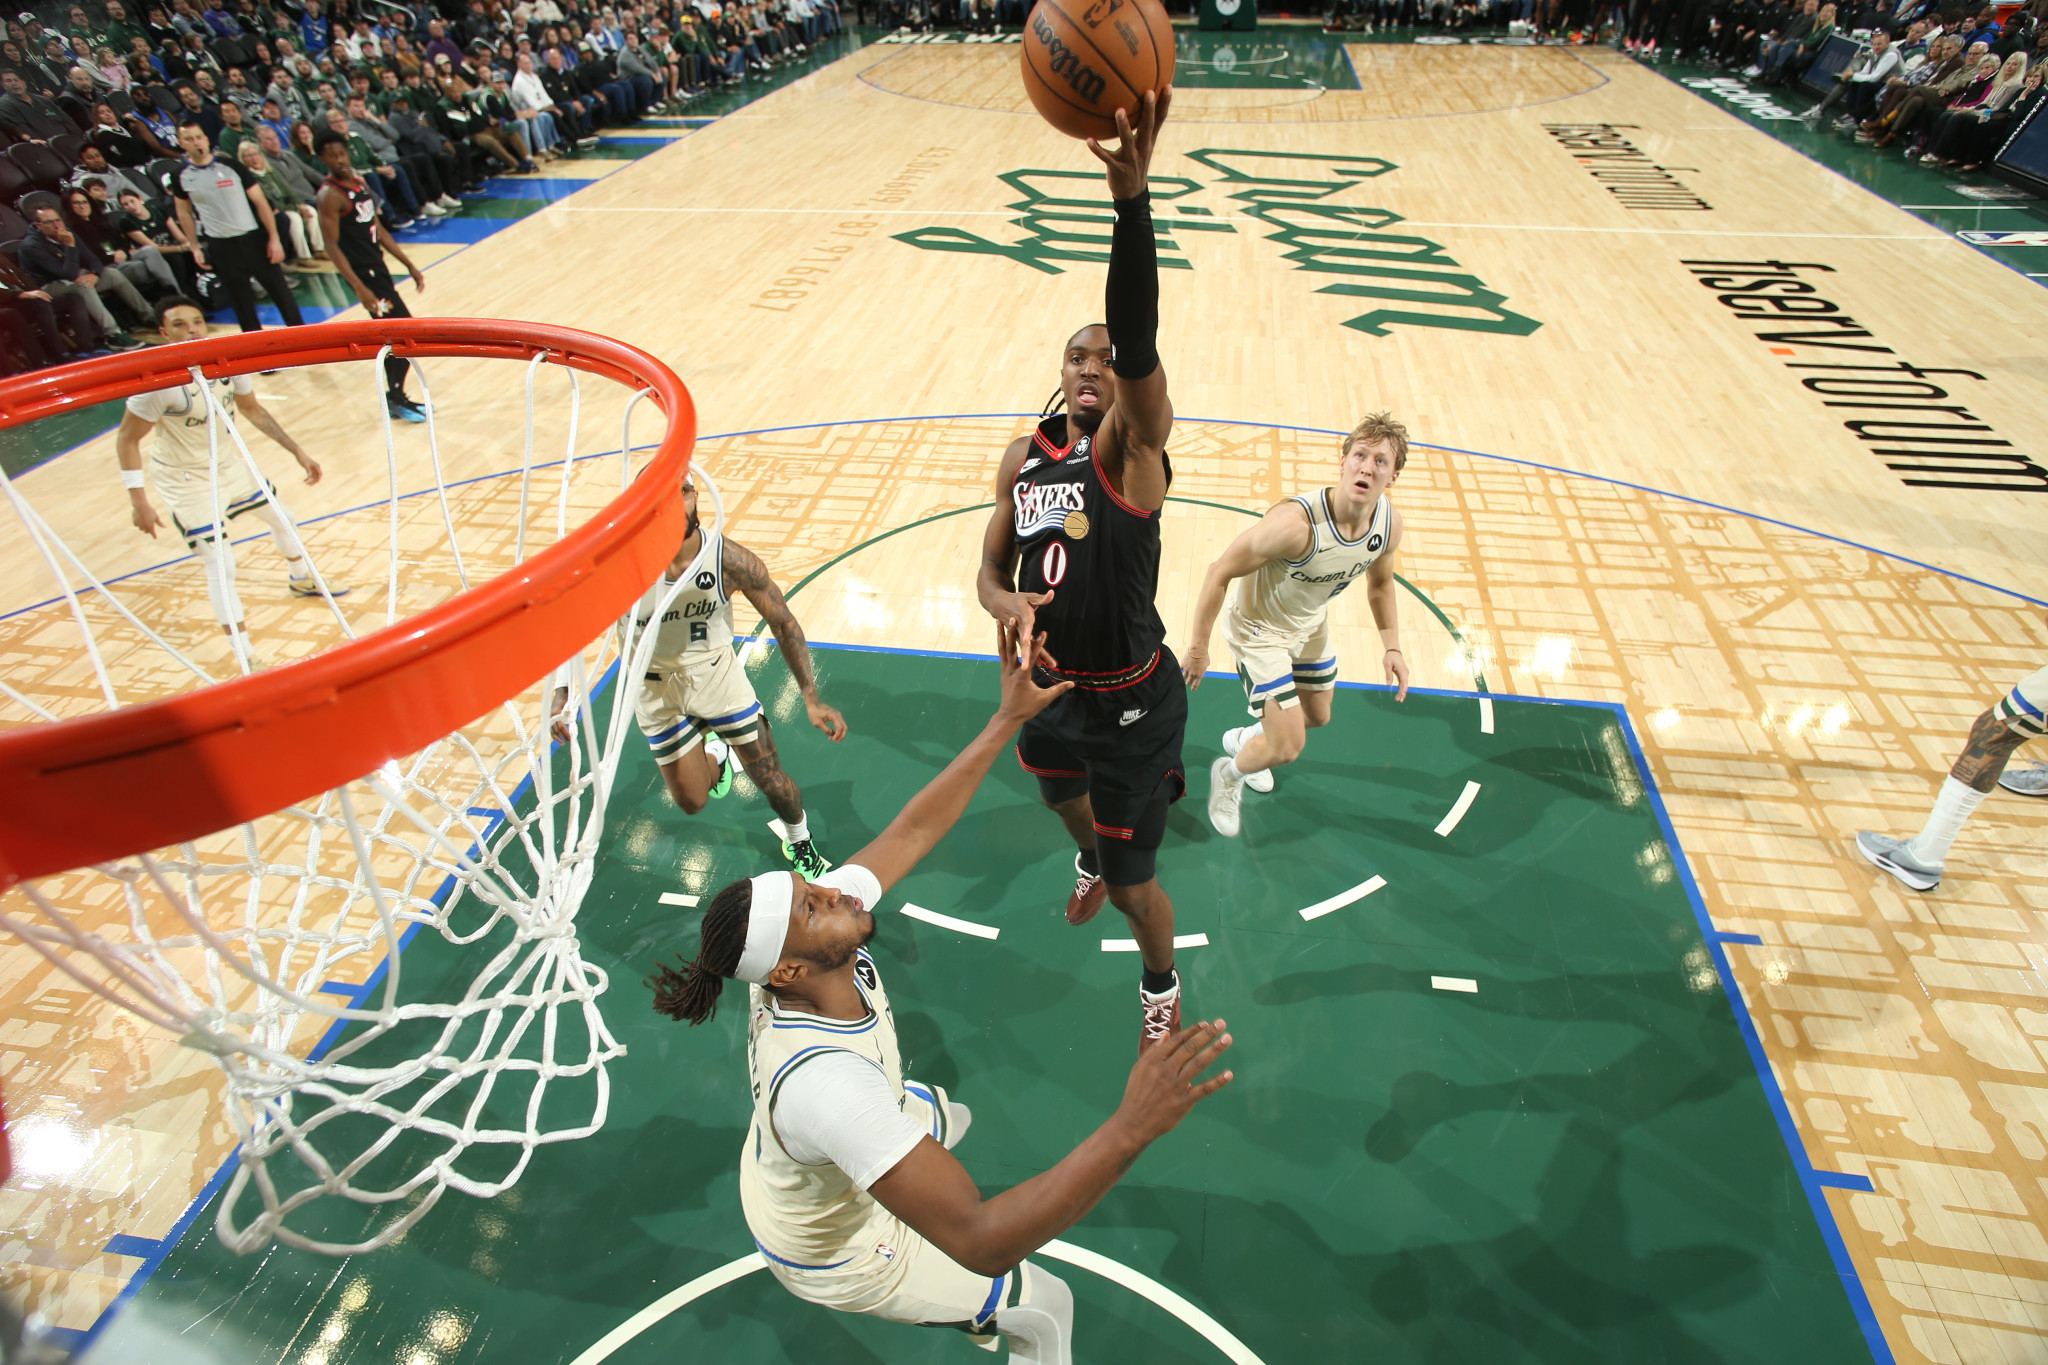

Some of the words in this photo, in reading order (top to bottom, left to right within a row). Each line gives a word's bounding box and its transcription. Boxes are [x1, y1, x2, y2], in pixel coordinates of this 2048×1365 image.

[1032, 9, 1107, 105] Wilson
[1184, 148, 1544, 336] Cream
[1013, 480, 1085, 529] SIXERS
[1042, 540, 1067, 587] 0
[1290, 570, 1347, 584] Cream
[683, 598, 718, 620] City
[690, 621, 708, 643] 5
[1123, 708, 1142, 721] NIKE
